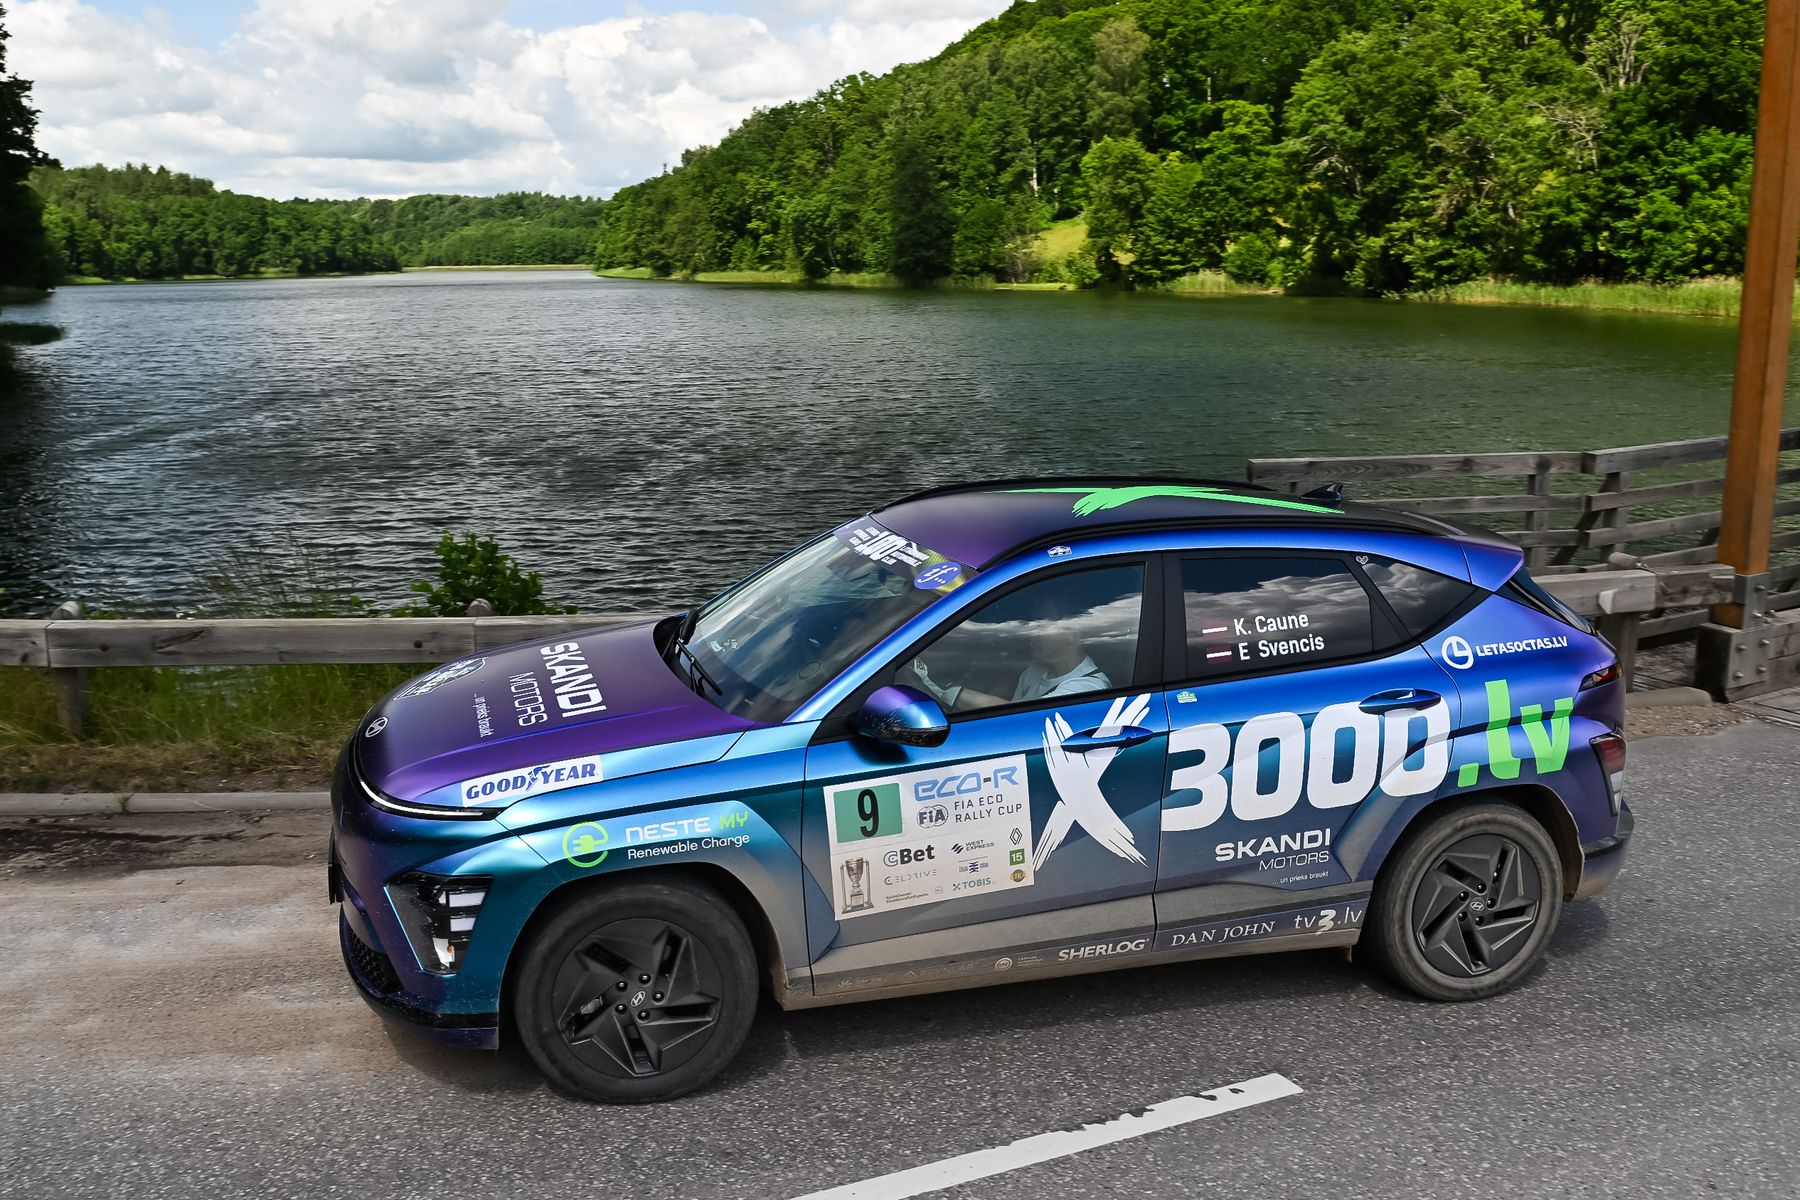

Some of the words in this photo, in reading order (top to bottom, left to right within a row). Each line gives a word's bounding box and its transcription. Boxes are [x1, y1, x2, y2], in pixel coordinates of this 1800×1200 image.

[1233, 617, 1252, 636] K.
[1254, 613, 1310, 633] Caune
[1258, 633, 1325, 658] Svencis
[1475, 636, 1568, 657] LETASOCTAS.LV
[540, 641, 607, 718] SKANDI
[508, 671, 548, 727] MOTORS
[466, 763, 596, 800] GOODYEAR
[857, 788, 880, 838] 9
[954, 800, 974, 811] FIA
[979, 793, 1003, 806] ECO
[955, 810, 992, 823] RALLY
[998, 803, 1023, 816] CUP
[719, 811, 749, 830] MY
[628, 840, 698, 860] Renewable
[702, 834, 750, 850] Charge
[966, 842, 995, 852] EXPRESS
[1215, 828, 1331, 862] SKANDI
[1011, 852, 1023, 863] 15
[1259, 850, 1329, 871] MOTORS
[962, 877, 992, 889] TOBIS
[1294, 906, 1362, 936] tv3.lv
[1170, 930, 1215, 947] DAN
[1219, 921, 1275, 943] JOHN
[1057, 939, 1146, 962] SHERLOG
